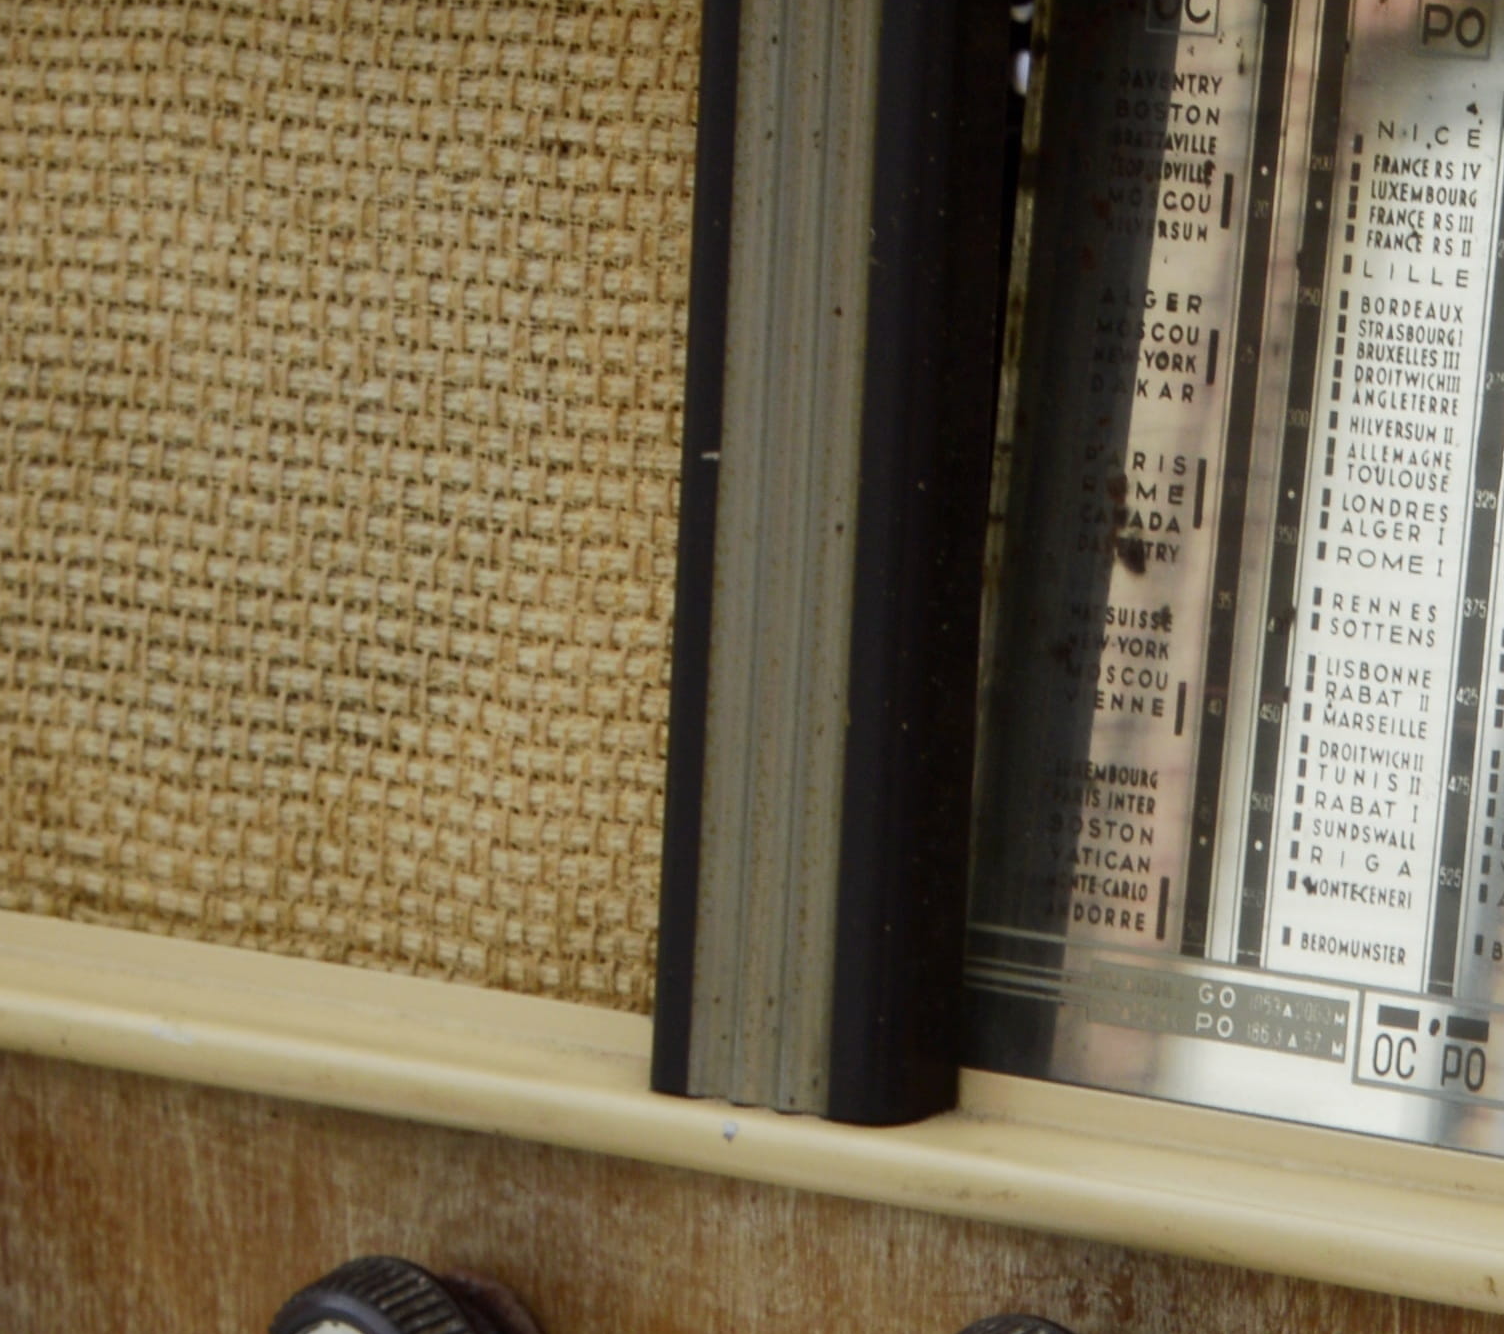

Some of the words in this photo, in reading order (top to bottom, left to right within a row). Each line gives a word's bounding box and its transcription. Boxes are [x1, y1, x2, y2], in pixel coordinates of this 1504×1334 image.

[1422, 3, 1485, 47] PO
[1115, 99, 1220, 127] BOSTON
[1378, 120, 1481, 149] NICE
[1373, 155, 1429, 177] FRANCE
[1435, 160, 1453, 179] RS
[1463, 163, 1481, 181] IV
[1371, 180, 1478, 208] LUXEMBOURG
[1369, 210, 1424, 229] FRANCE
[1433, 212, 1453, 231] RS
[1366, 230, 1422, 253] FRANCE
[1433, 237, 1453, 256] RS
[1364, 263, 1469, 288] LILLE
[1100, 286, 1203, 315] ALGER
[1361, 296, 1464, 324] BORDEAUX
[1097, 318, 1200, 347] MOSCOU
[1357, 342, 1438, 365] BRUXELLES
[1091, 374, 1195, 404] DAKAR
[1352, 388, 1459, 416] ANGLETERRE
[1350, 416, 1436, 442] HILVERSUM
[1085, 444, 1188, 476] PARIS
[1348, 442, 1453, 471] ALLEMAGNE
[1082, 475, 1184, 506] RME
[1347, 464, 1450, 492] TOULOUSE
[1342, 494, 1448, 523] LONDRES
[1475, 489, 1496, 509] 325
[1340, 519, 1420, 542] ALGER
[1336, 547, 1423, 573] ROME
[1105, 605, 1173, 634] SUISSE
[1333, 593, 1437, 623] RENNES
[1464, 598, 1487, 618] 375
[1330, 618, 1435, 648] SOTTENS
[1327, 657, 1432, 689] LISBONNE
[1325, 682, 1402, 707] RABAT
[1323, 709, 1428, 740] MARSEILLE
[1319, 764, 1398, 792] TUNIS
[1107, 792, 1156, 816] INTER
[1315, 791, 1397, 818] RABAT
[1313, 819, 1416, 849] SUNDSWALL
[1311, 846, 1412, 877] RIGA
[1439, 866, 1461, 887] 525
[1301, 933, 1406, 965] BEROMUNSTER
[1199, 983, 1236, 1009] GO
[1196, 1011, 1233, 1038] PO
[1373, 1033, 1417, 1079] OC
[1441, 1044, 1486, 1092] PO
